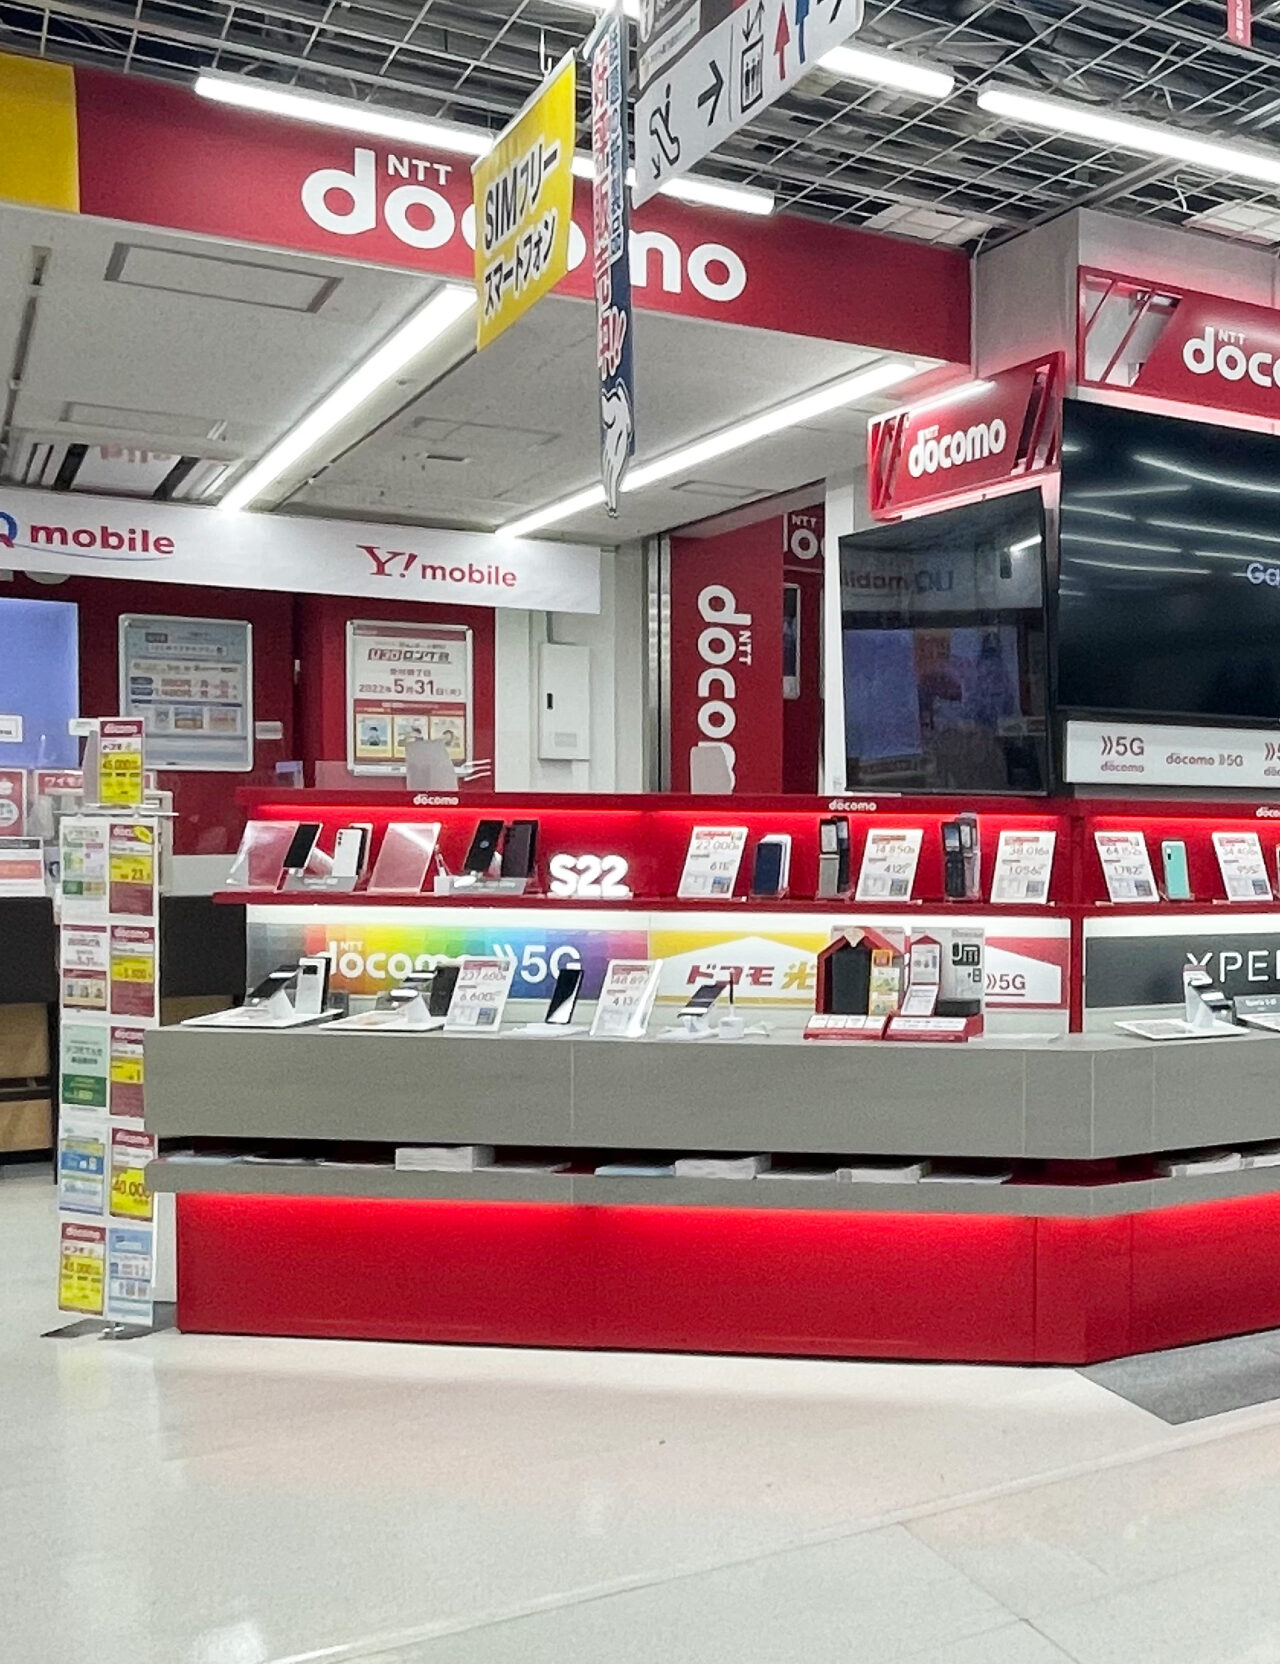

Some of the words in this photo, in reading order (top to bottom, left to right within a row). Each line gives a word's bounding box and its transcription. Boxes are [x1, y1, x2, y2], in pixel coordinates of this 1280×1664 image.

[388, 154, 452, 184] NTT
[484, 149, 558, 251] SIMフリー
[484, 217, 556, 318] スマートフォン
[1218, 329, 1246, 345] NTT
[908, 418, 1006, 478] docomo
[792, 515, 816, 527] NTT
[30, 524, 175, 555] mobile
[739, 631, 751, 666] NTT
[1115, 738, 1144, 756] 5G
[1101, 761, 1144, 773] docomo
[1166, 752, 1215, 766] docomo
[413, 794, 459, 806] docomo
[829, 799, 877, 811] docomo
[549, 853, 629, 896] S22
[340, 942, 364, 951] NTT
[520, 945, 582, 984] 5G
[998, 973, 1026, 991] 5G
